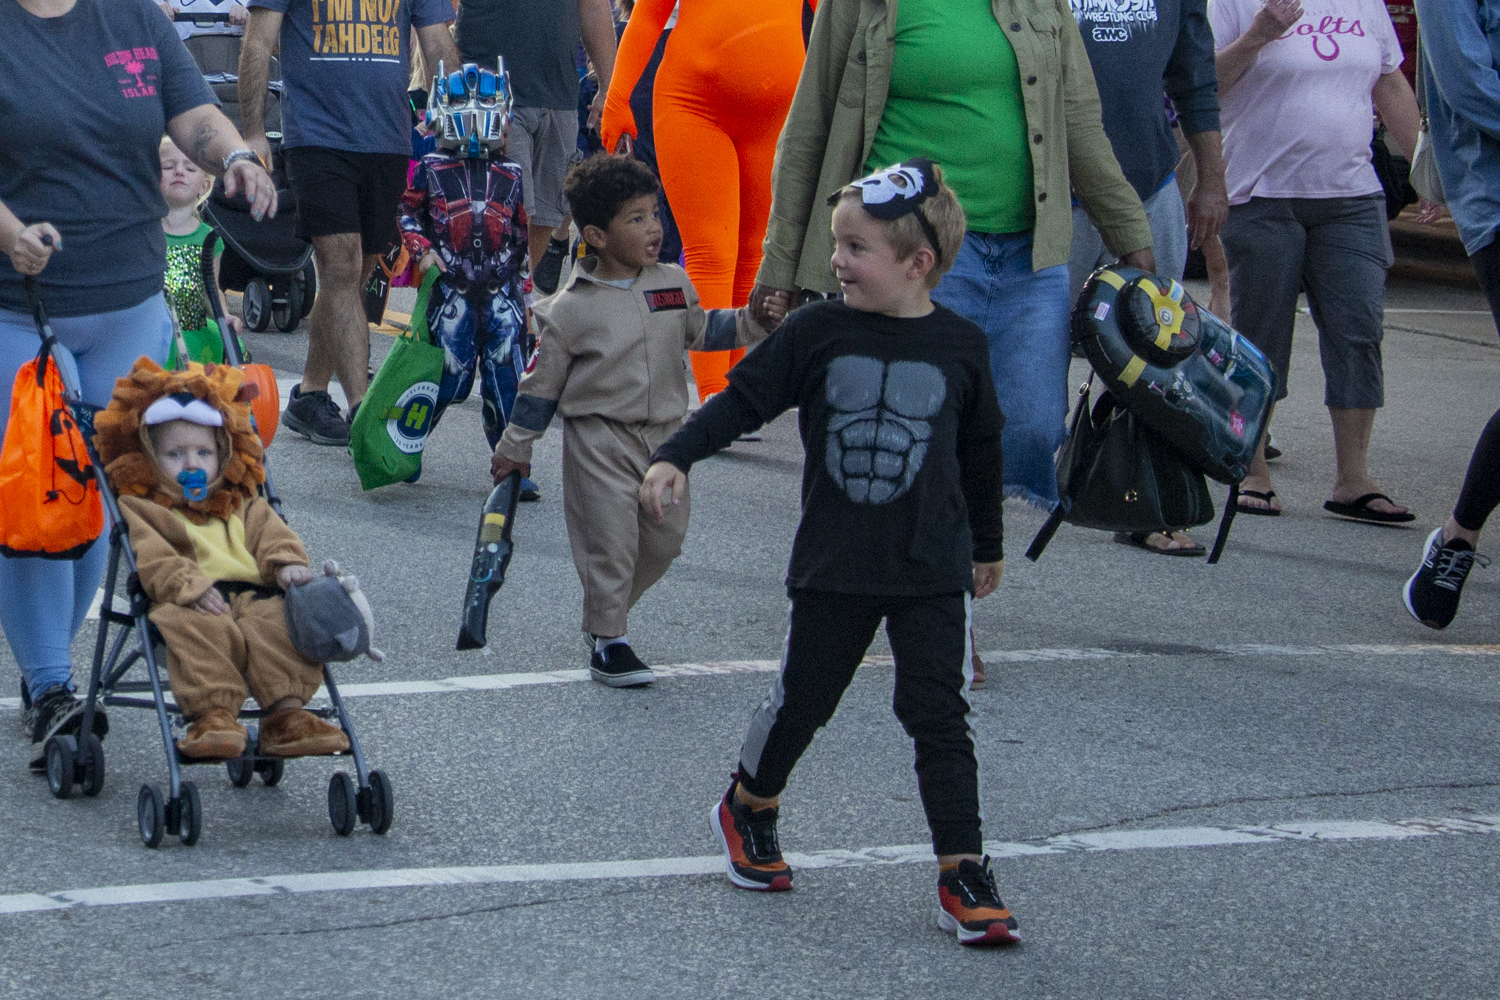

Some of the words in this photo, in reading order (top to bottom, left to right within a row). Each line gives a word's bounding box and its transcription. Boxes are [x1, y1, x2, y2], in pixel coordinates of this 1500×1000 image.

[1084, 10, 1134, 23] WRESTLING
[1136, 10, 1158, 21] CLUB
[405, 385, 438, 399] CELEBRAT
[404, 402, 428, 430] H
